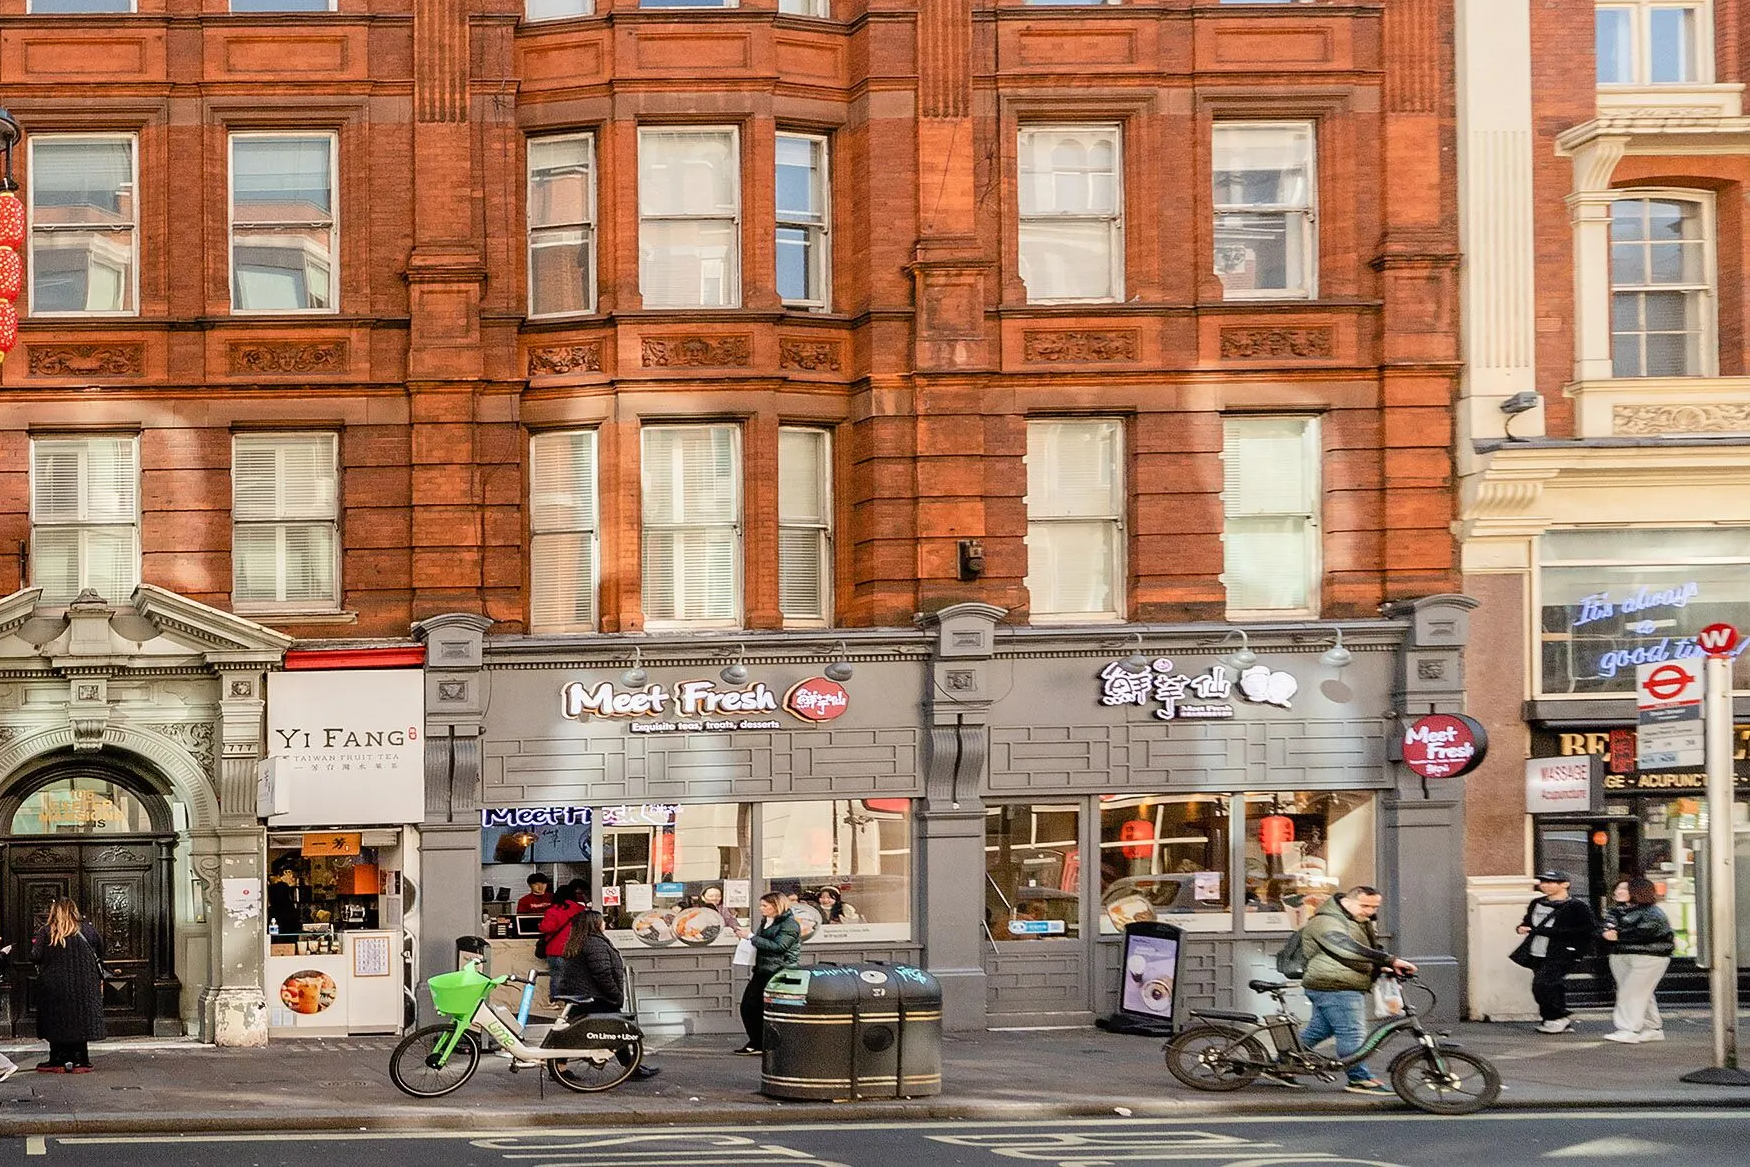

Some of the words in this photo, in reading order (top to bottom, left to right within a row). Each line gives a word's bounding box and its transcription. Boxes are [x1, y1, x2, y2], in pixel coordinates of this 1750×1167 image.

[1598, 637, 1669, 678] good
[567, 682, 669, 716] Meet
[682, 682, 778, 715] Fresh
[740, 719, 780, 730] desserts
[1405, 725, 1458, 745] Meet
[1426, 742, 1475, 760] Fresh
[1540, 764, 1588, 783] MASSAGE
[487, 1020, 516, 1047] Lime
[586, 1032, 598, 1040] On
[623, 1033, 639, 1041] Uber
